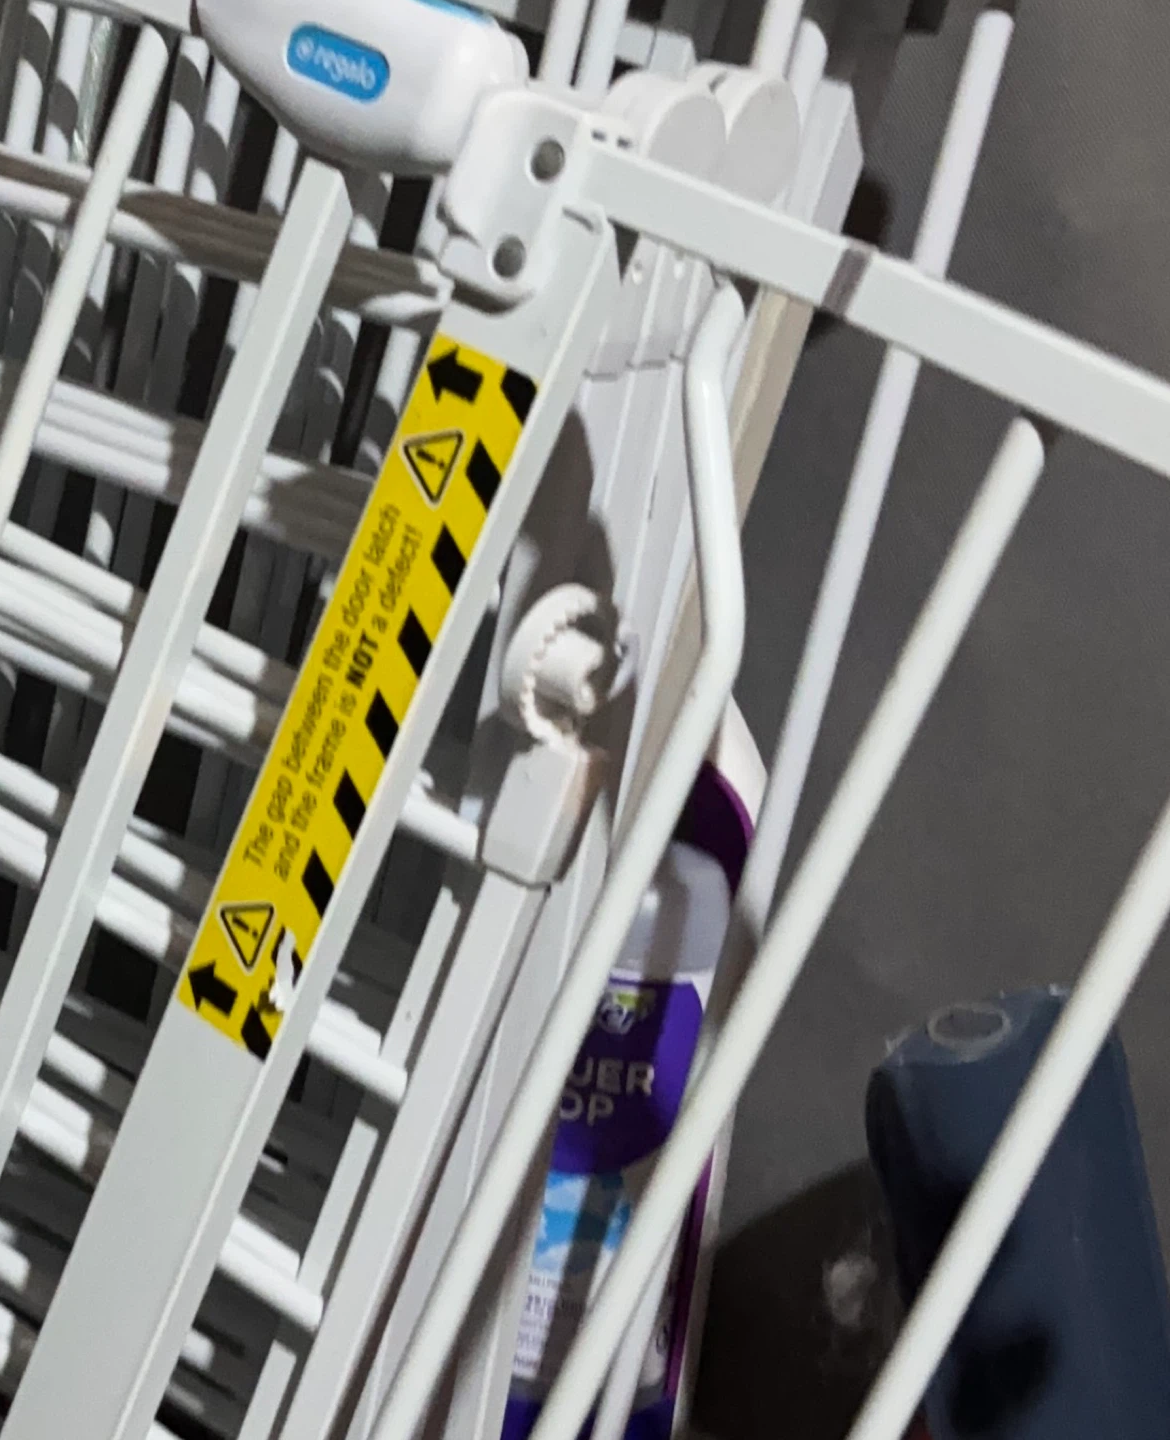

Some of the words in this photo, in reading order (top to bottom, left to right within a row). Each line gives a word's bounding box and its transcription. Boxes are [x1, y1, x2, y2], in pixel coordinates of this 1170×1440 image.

[314, 45, 376, 90] regalo
[363, 502, 401, 566] latch
[377, 523, 423, 614] defect!
[342, 567, 375, 629] door
[370, 616, 388, 633] a
[322, 629, 351, 670] the
[345, 629, 381, 690] NOT
[280, 675, 334, 773] between
[334, 690, 357, 717] is
[306, 716, 347, 788] frame
[266, 773, 295, 822] gap
[289, 790, 318, 834] the
[243, 821, 274, 867] The
[273, 836, 300, 881] and
[559, 1088, 615, 1127] OP
